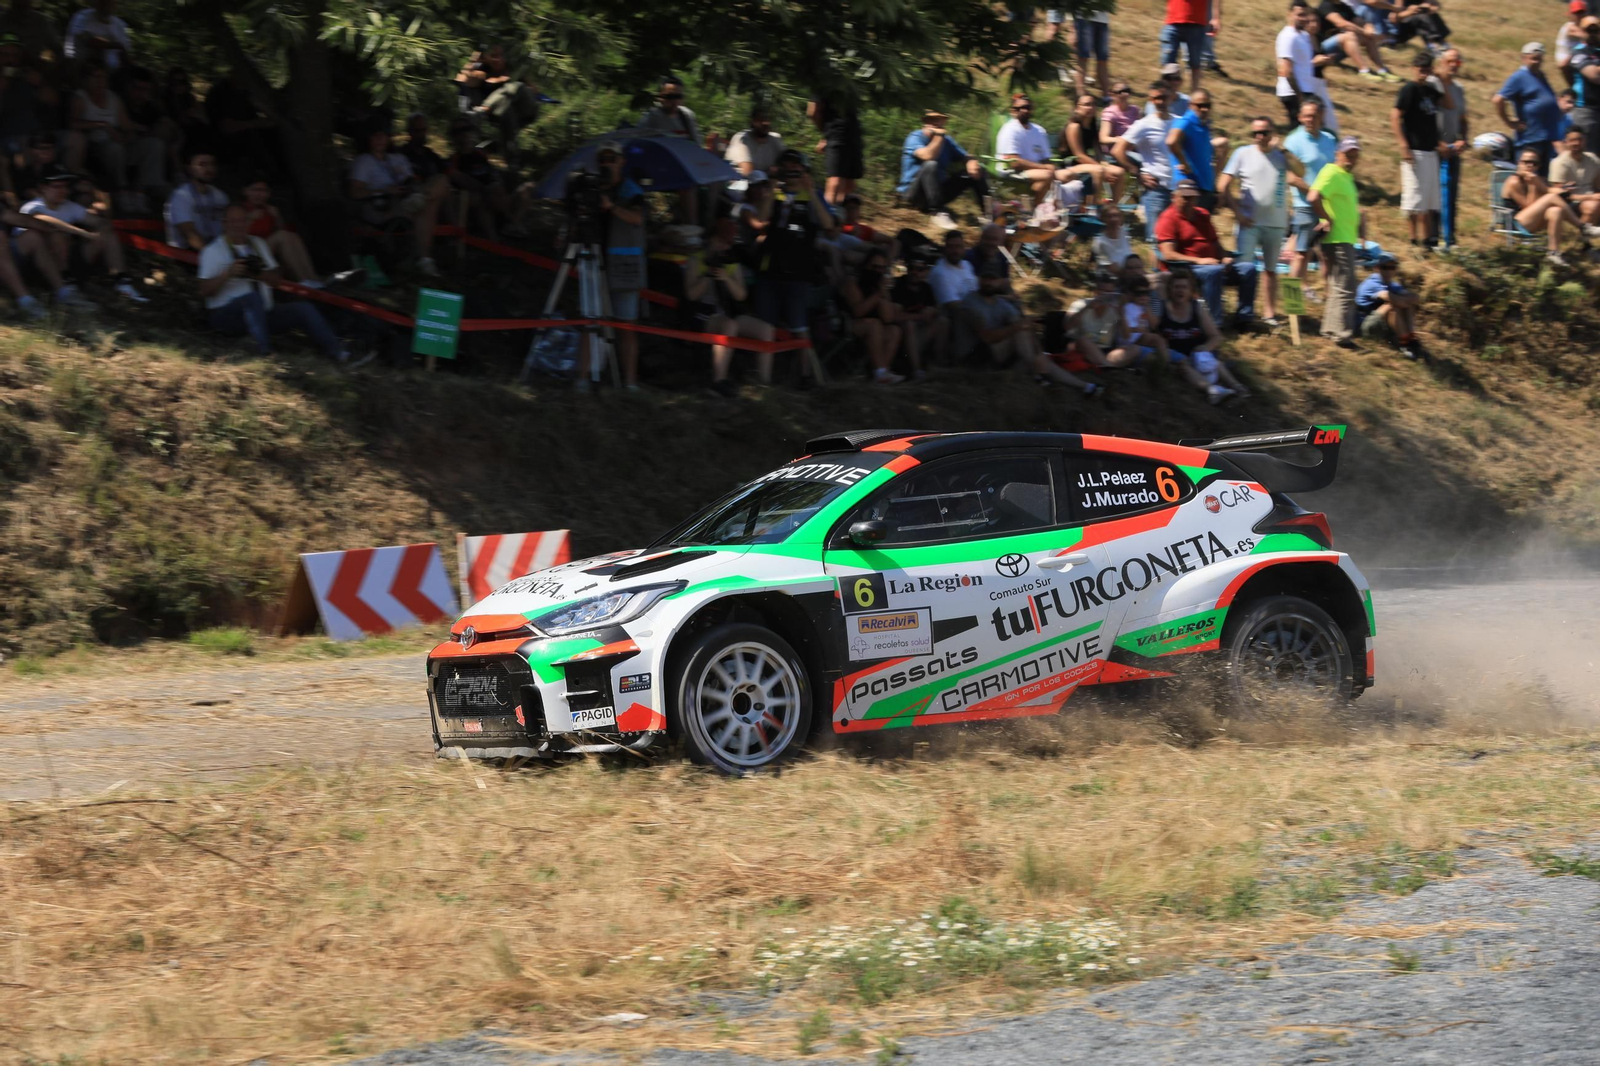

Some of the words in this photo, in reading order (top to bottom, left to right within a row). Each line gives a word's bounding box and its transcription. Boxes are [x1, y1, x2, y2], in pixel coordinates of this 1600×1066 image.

[1077, 471, 1147, 488] J.L.Pelaez
[1155, 466, 1180, 502] 6
[1082, 488, 1159, 509] J.Murado
[1219, 485, 1255, 508] CAR
[854, 578, 875, 608] 6
[888, 580, 915, 594] La
[989, 583, 1034, 601] Comauto
[1036, 577, 1051, 589] Sur
[870, 616, 907, 629] Recalvi
[1136, 617, 1216, 647] VALLEROS
[874, 640, 909, 650] recoletas
[911, 637, 930, 647] salud
[1195, 630, 1216, 641] SPORT
[941, 635, 1103, 712] CARMOTIVE
[1022, 684, 1041, 695] POR
[1043, 676, 1061, 687] LOS
[1063, 661, 1098, 680] COCHES
[573, 720, 614, 728] RACING
[581, 708, 613, 722] PAGID
